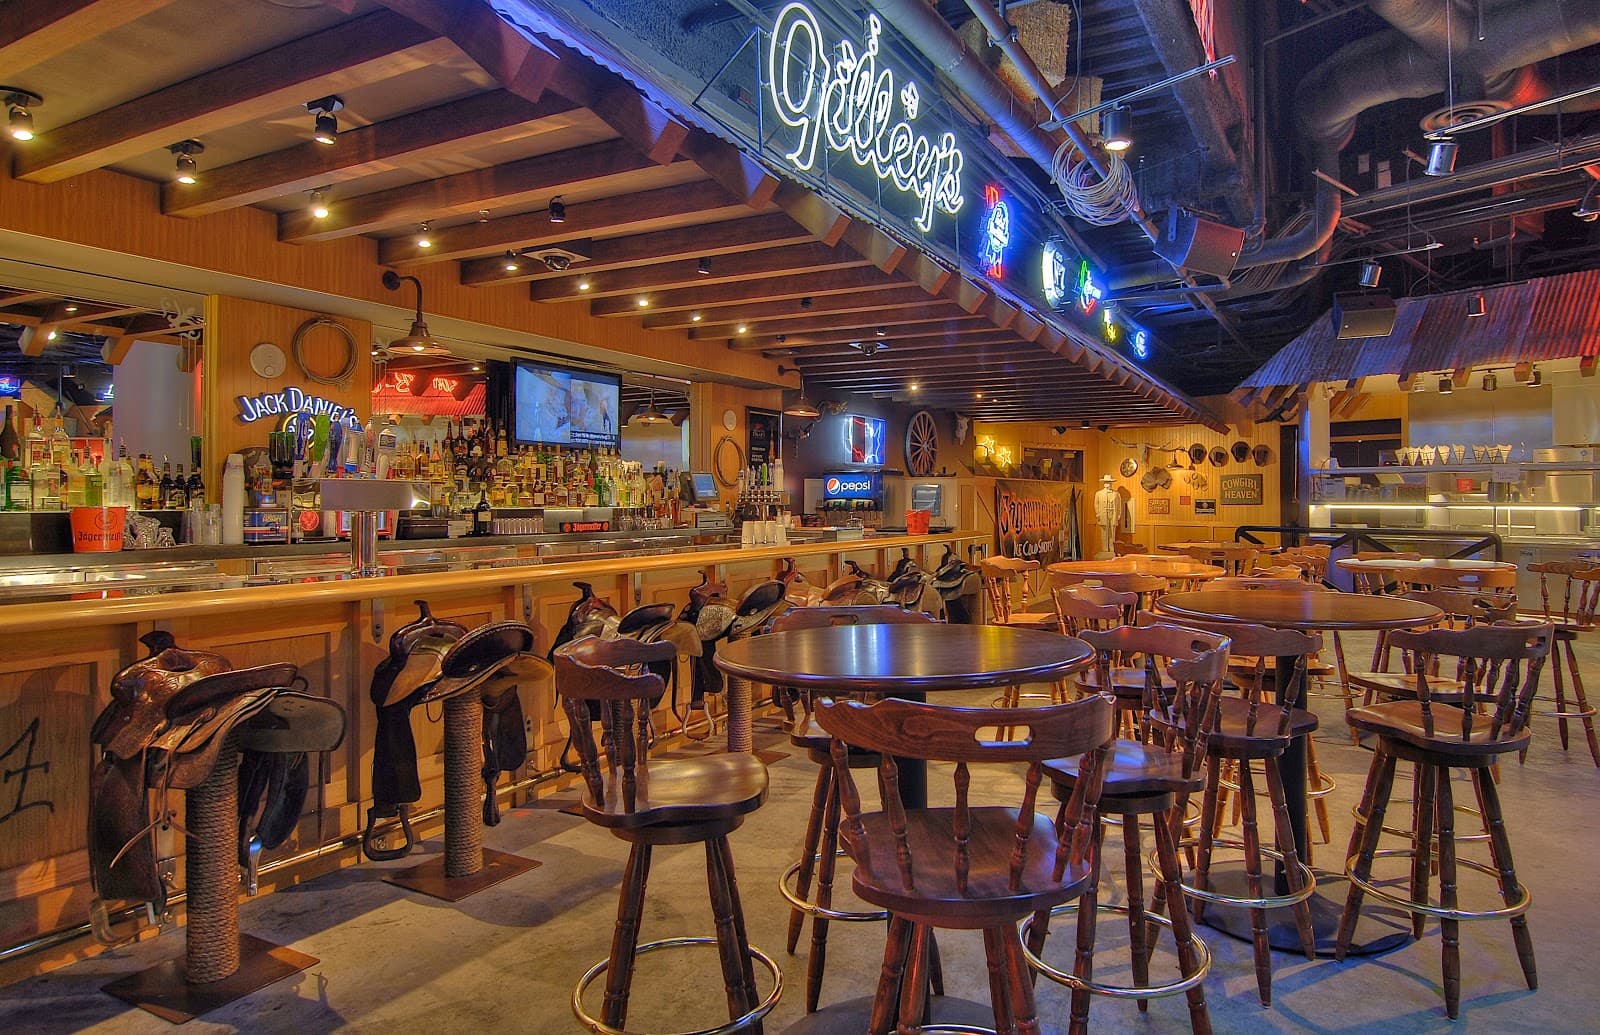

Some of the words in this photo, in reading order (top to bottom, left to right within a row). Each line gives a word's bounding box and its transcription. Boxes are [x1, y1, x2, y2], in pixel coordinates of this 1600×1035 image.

[241, 393, 289, 422] JACK
[840, 480, 871, 493] pepsi
[1222, 477, 1260, 490] COWGIRL
[1224, 489, 1257, 499] HEAVEN
